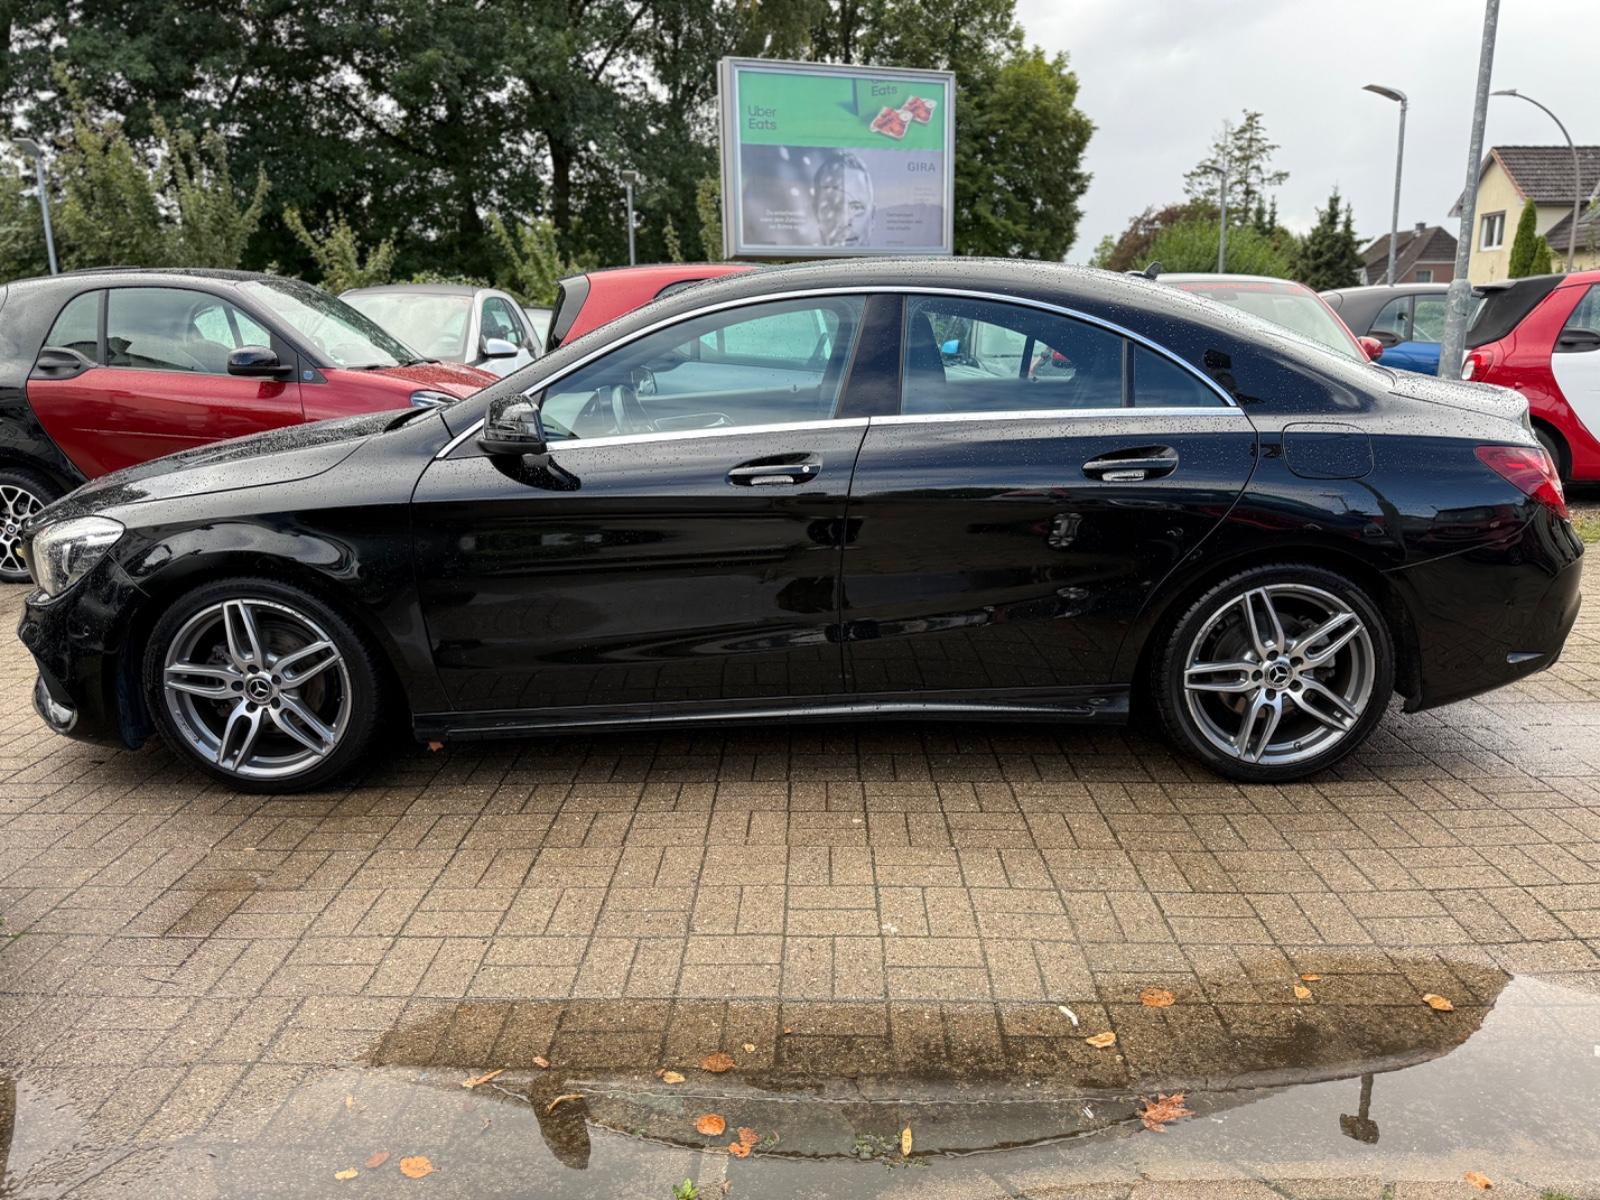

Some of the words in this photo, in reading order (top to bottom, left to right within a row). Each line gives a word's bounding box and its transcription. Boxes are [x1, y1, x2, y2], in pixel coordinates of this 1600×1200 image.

[871, 86, 897, 97] Eats
[747, 104, 776, 117] Uber
[748, 118, 776, 130] Eats
[907, 162, 936, 172] GIRA
